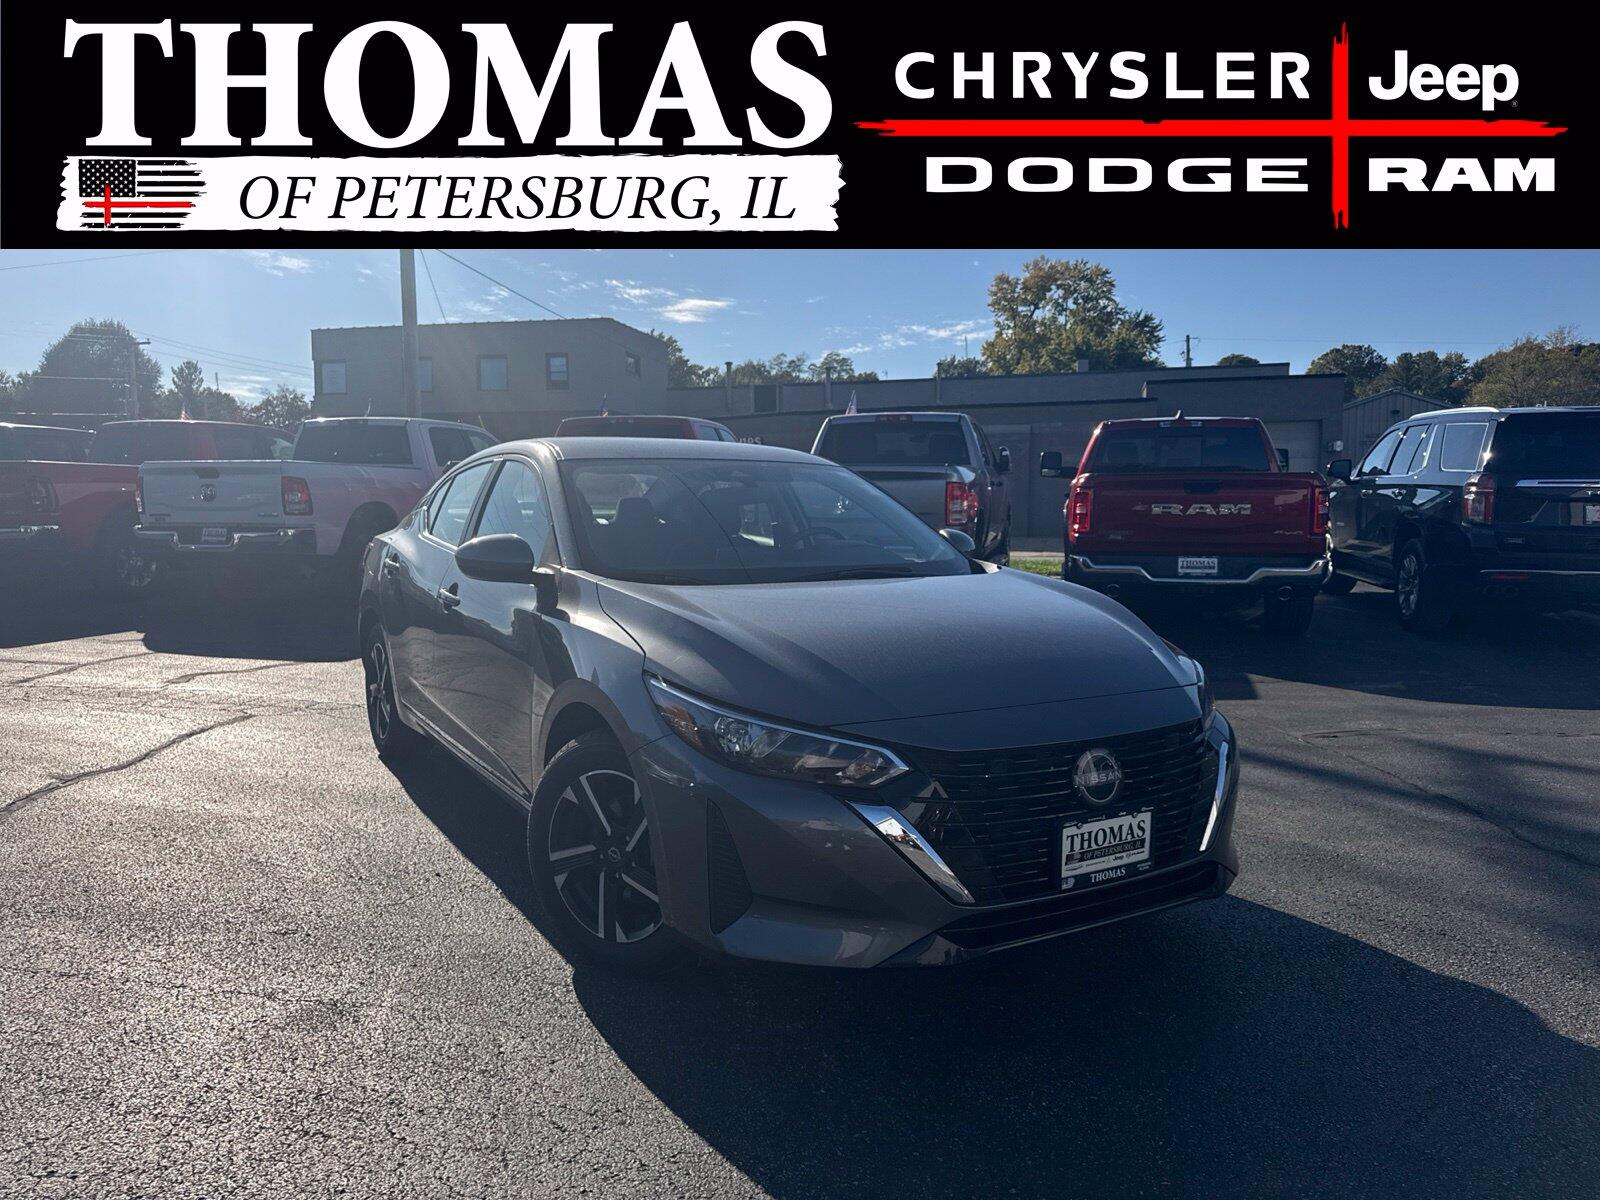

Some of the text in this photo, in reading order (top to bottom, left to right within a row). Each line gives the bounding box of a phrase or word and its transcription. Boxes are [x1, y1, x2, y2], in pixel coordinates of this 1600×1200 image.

[1151, 503, 1252, 515] RAM
[1180, 559, 1216, 567] THOMAS
[1073, 770, 1122, 785] NISSAN
[1066, 819, 1146, 853] THOMAS
[1090, 867, 1126, 883] THOMAS
